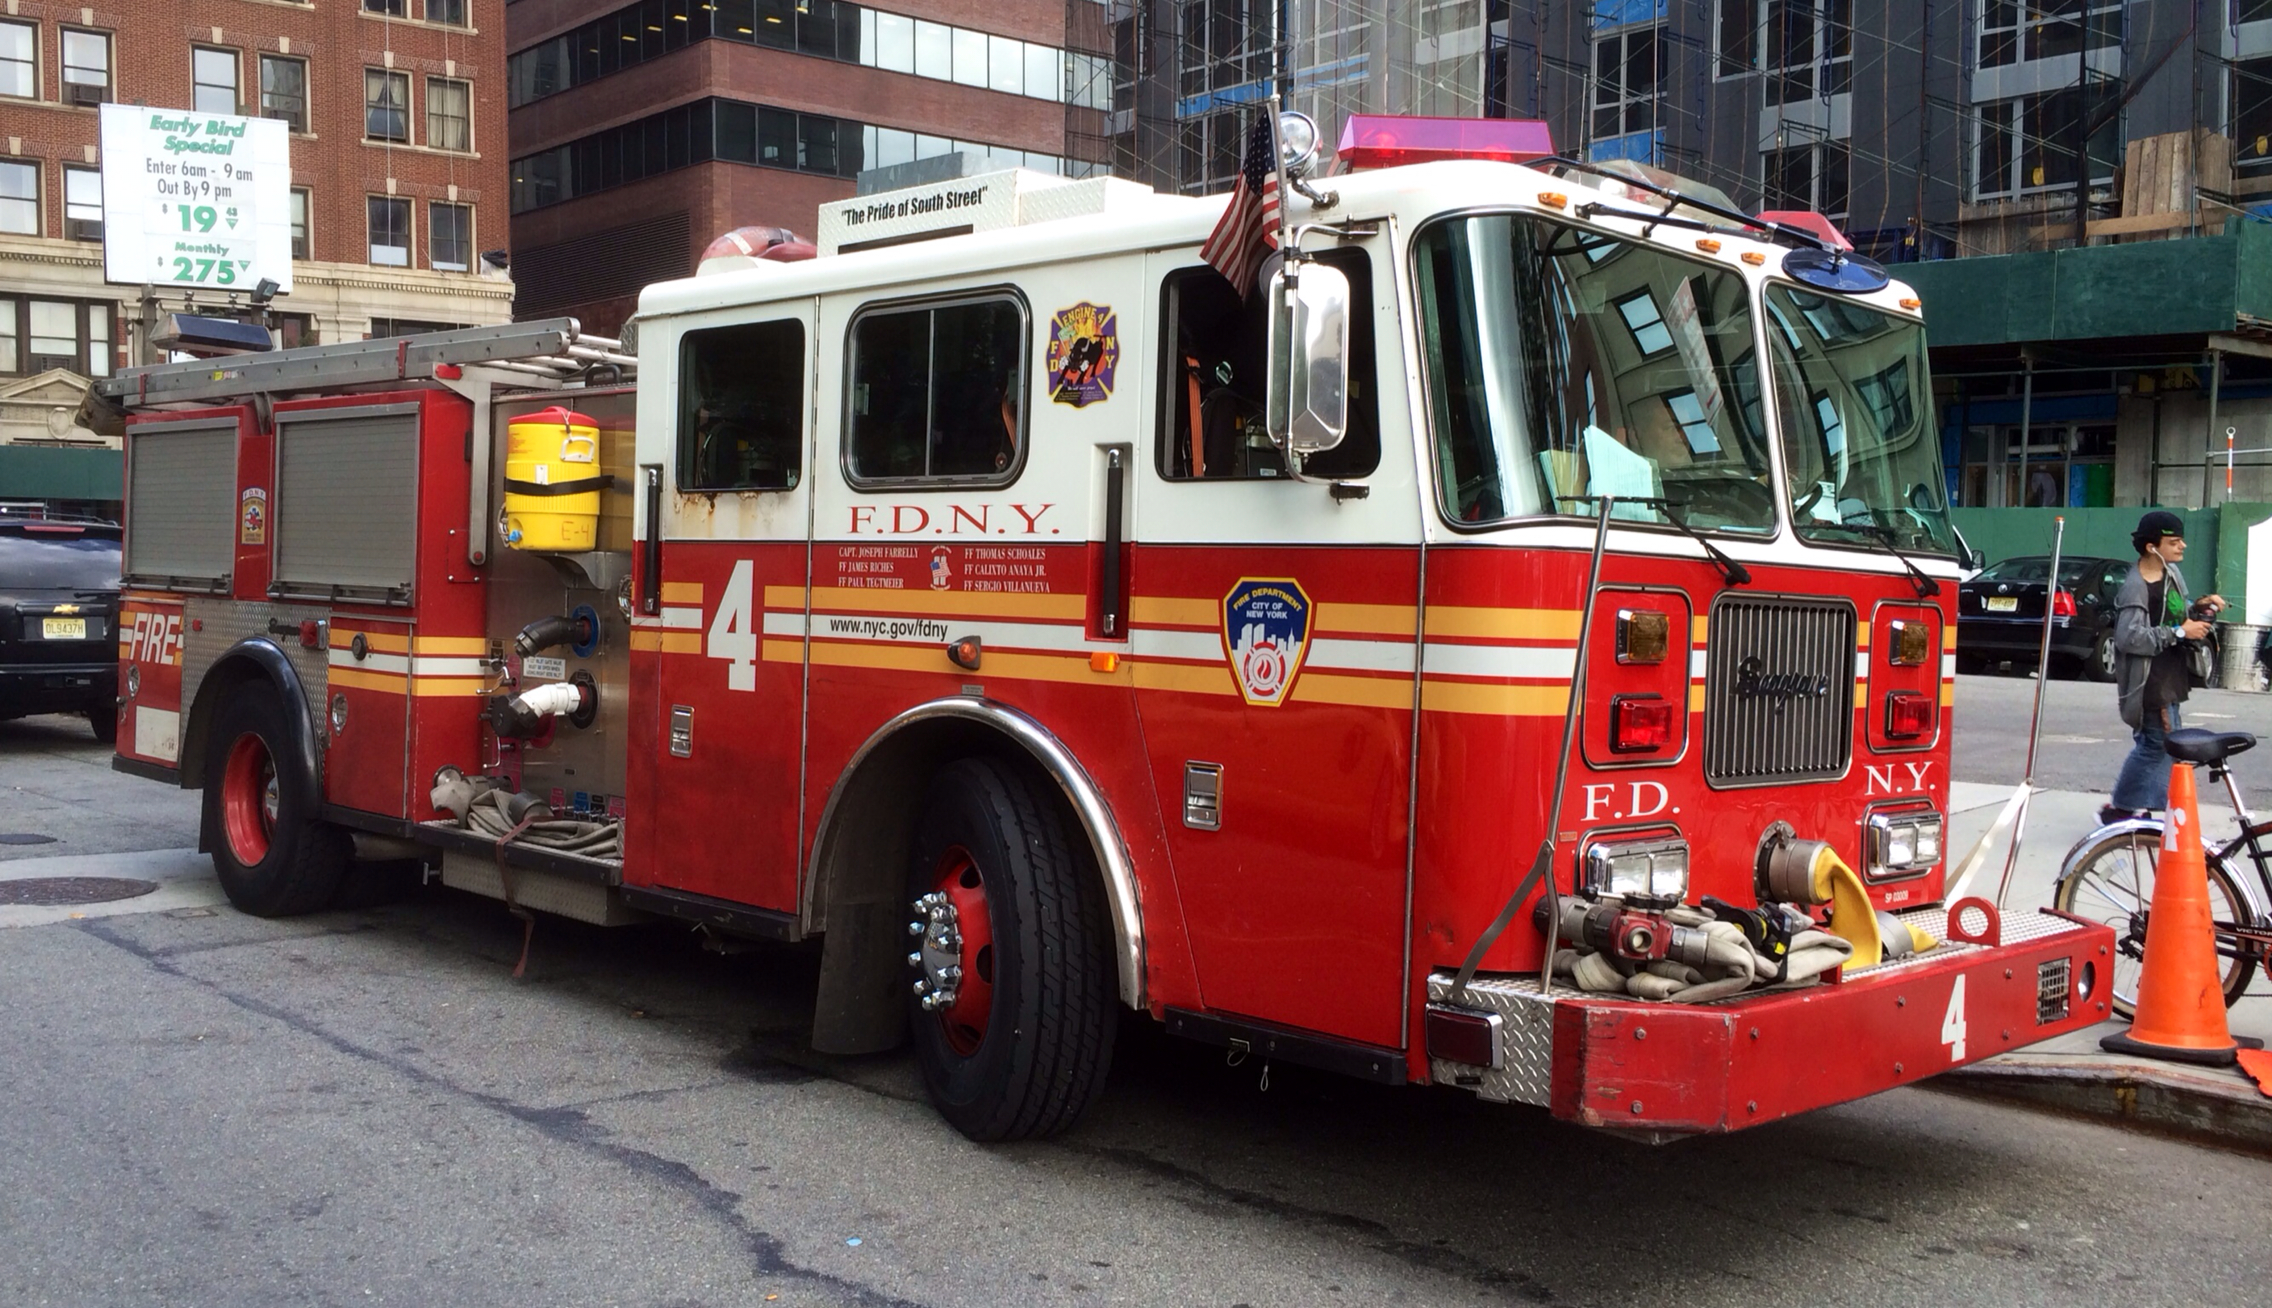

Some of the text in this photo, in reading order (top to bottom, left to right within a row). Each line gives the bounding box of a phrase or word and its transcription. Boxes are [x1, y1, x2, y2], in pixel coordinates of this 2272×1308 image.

[150, 115, 247, 138] Early Bird
[163, 135, 235, 155] Special
[146, 157, 177, 175] Enter
[181, 160, 207, 177] 6am
[223, 163, 233, 178] 9
[236, 169, 253, 181] am
[157, 178, 232, 201] Out By 9 pm
[178, 204, 218, 233] 19
[867, 202, 895, 222] Pride
[898, 199, 909, 217] of
[911, 193, 944, 215] South
[175, 242, 230, 257] Monthly
[173, 256, 236, 285] 275
[1062, 306, 1097, 326] ENGINE
[847, 504, 1060, 534] F.D.N.Y.
[562, 520, 589, 543] E-4
[839, 547, 857, 558] CAPT.
[858, 547, 883, 558] JOSEPH
[884, 547, 919, 558] FARRELLY
[964, 548, 974, 559] FF
[976, 548, 1005, 560] THOMAS
[1007, 548, 1046, 560] SCHOALES
[839, 561, 894, 573] FF JAMES RICHES
[964, 564, 1047, 577] FF CALIXTO ANAYA JR.
[838, 576, 847, 587] FF
[848, 577, 865, 588] PAUL
[963, 580, 973, 591] FF
[974, 580, 1002, 592] SERGIO
[1003, 581, 1050, 593] VILLANUEVA
[1232, 587, 1302, 612] FIRE DEPARTMENT
[1251, 602, 1283, 610] CITY OF
[707, 559, 757, 692] 4
[1246, 610, 1288, 619] NEW YORK
[129, 611, 181, 665] FIRE
[830, 618, 948, 641] www.nyc.gov/fdny
[1864, 761, 1936, 795] N.Y.
[1580, 780, 1681, 821] F.D.
[1941, 973, 1966, 1062] 4
